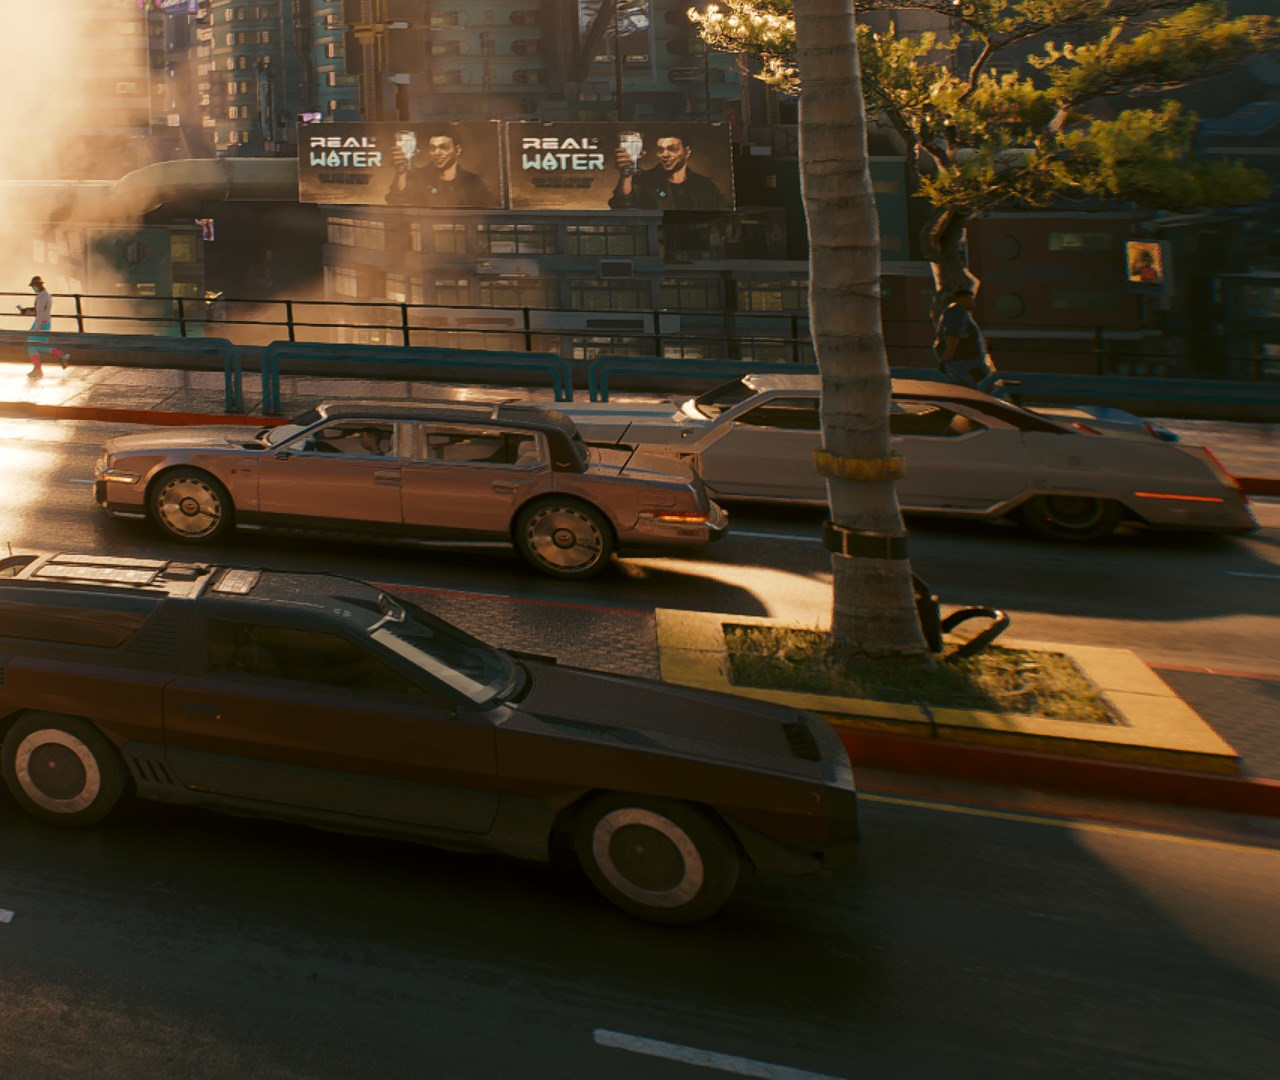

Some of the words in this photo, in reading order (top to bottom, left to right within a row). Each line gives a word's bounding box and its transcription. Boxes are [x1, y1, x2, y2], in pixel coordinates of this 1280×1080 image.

[310, 136, 376, 148] REAL
[522, 137, 598, 149] REAL
[310, 150, 382, 167] WATER
[522, 151, 605, 170] WATER
